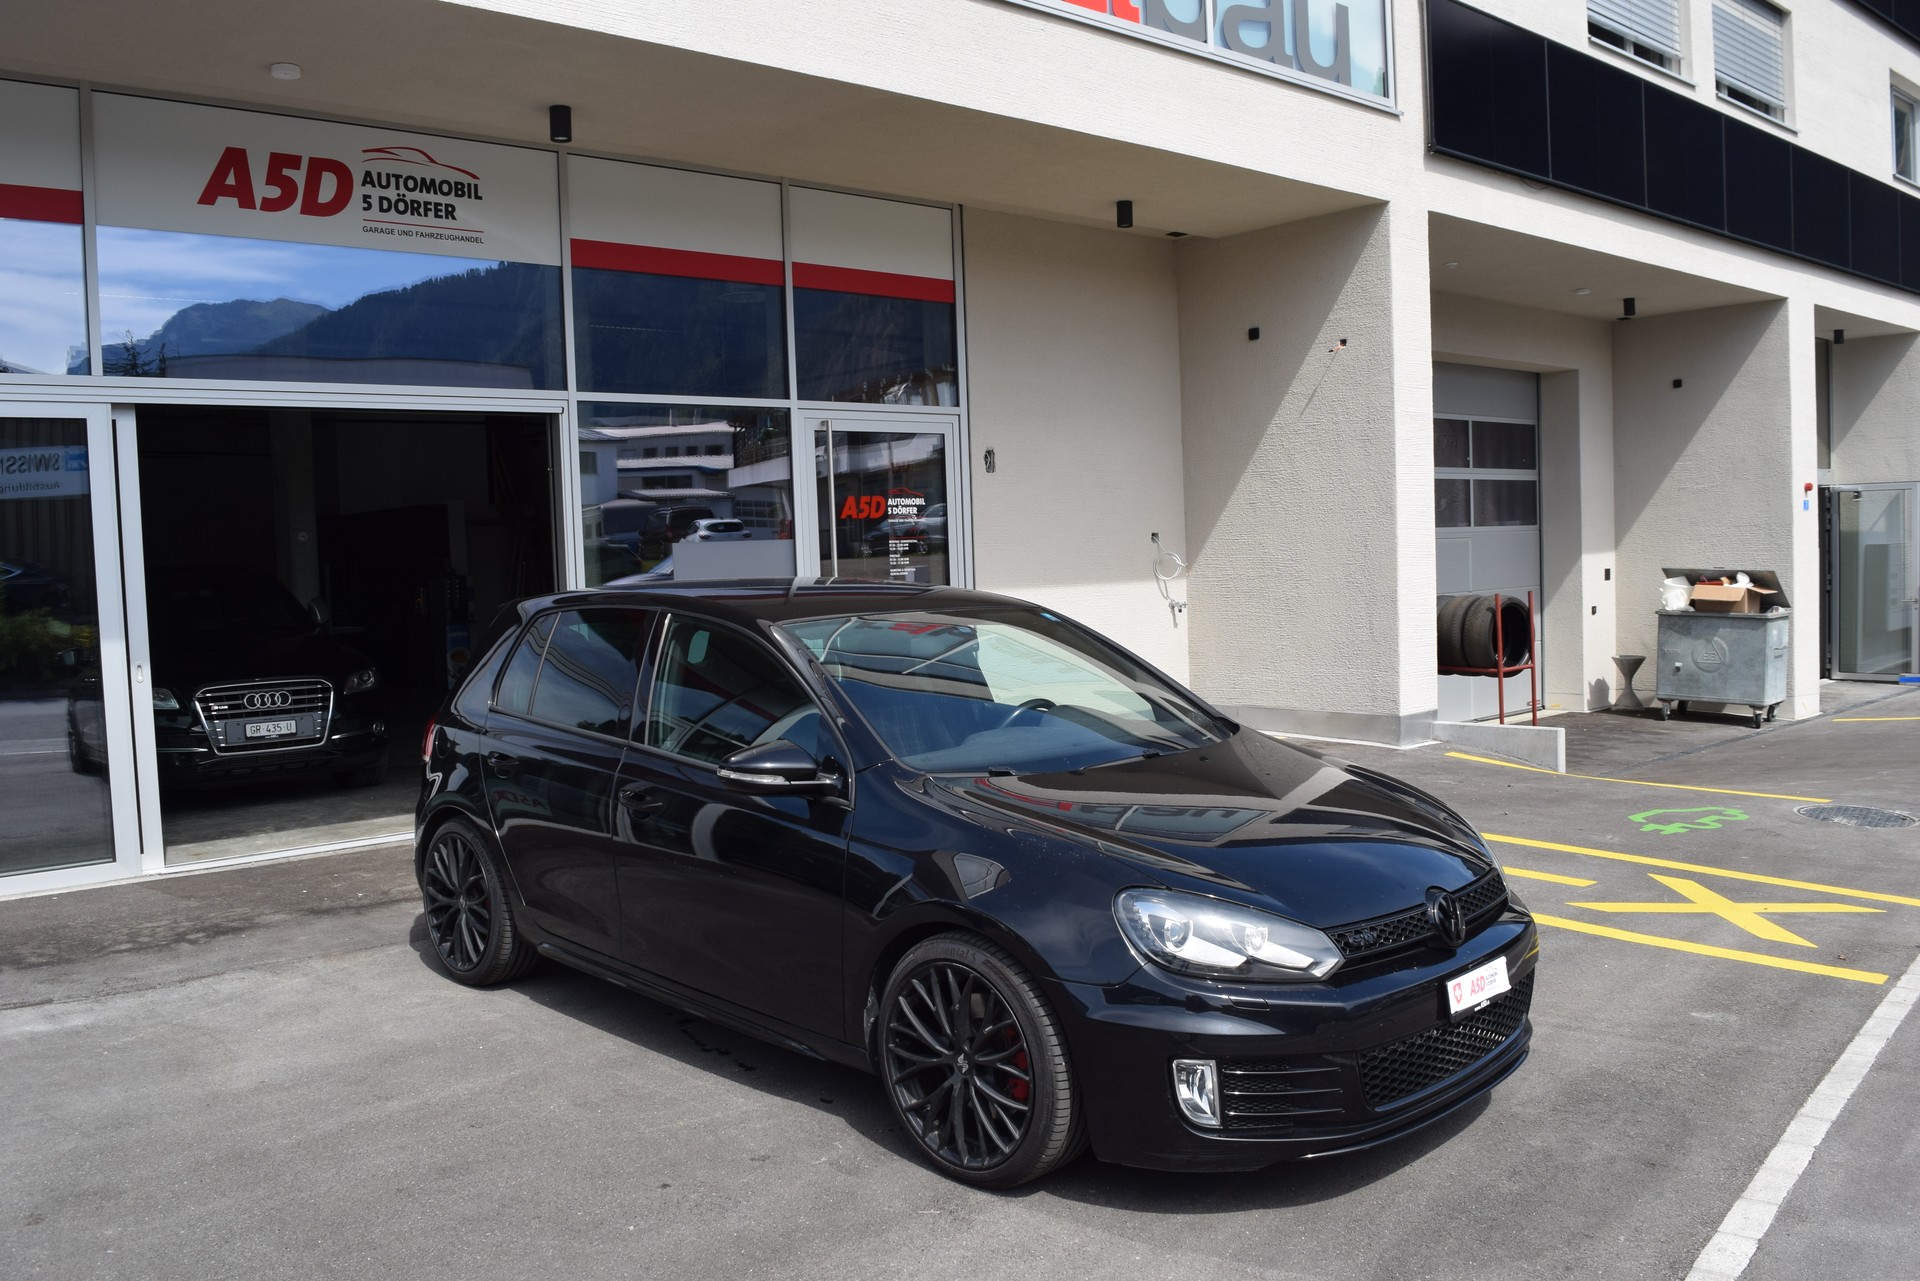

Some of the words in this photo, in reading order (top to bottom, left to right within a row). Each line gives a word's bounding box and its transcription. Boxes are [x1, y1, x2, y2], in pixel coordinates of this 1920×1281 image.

[197, 146, 353, 217] A5D
[361, 170, 483, 200] AUTOMOBIL
[362, 194, 373, 211] 5
[379, 193, 457, 221] DÖRFER
[362, 225, 396, 237] GARAGE
[397, 229, 413, 238] UND
[415, 230, 484, 244] FAHRZEUGHANDEL
[840, 496, 886, 519] A5D
[887, 498, 926, 506] AUTOMOBIL
[893, 506, 918, 515] DÖRFER
[250, 724, 261, 735] GR
[266, 723, 282, 733] 435
[286, 722, 292, 732] U
[1470, 975, 1486, 997] A5D
